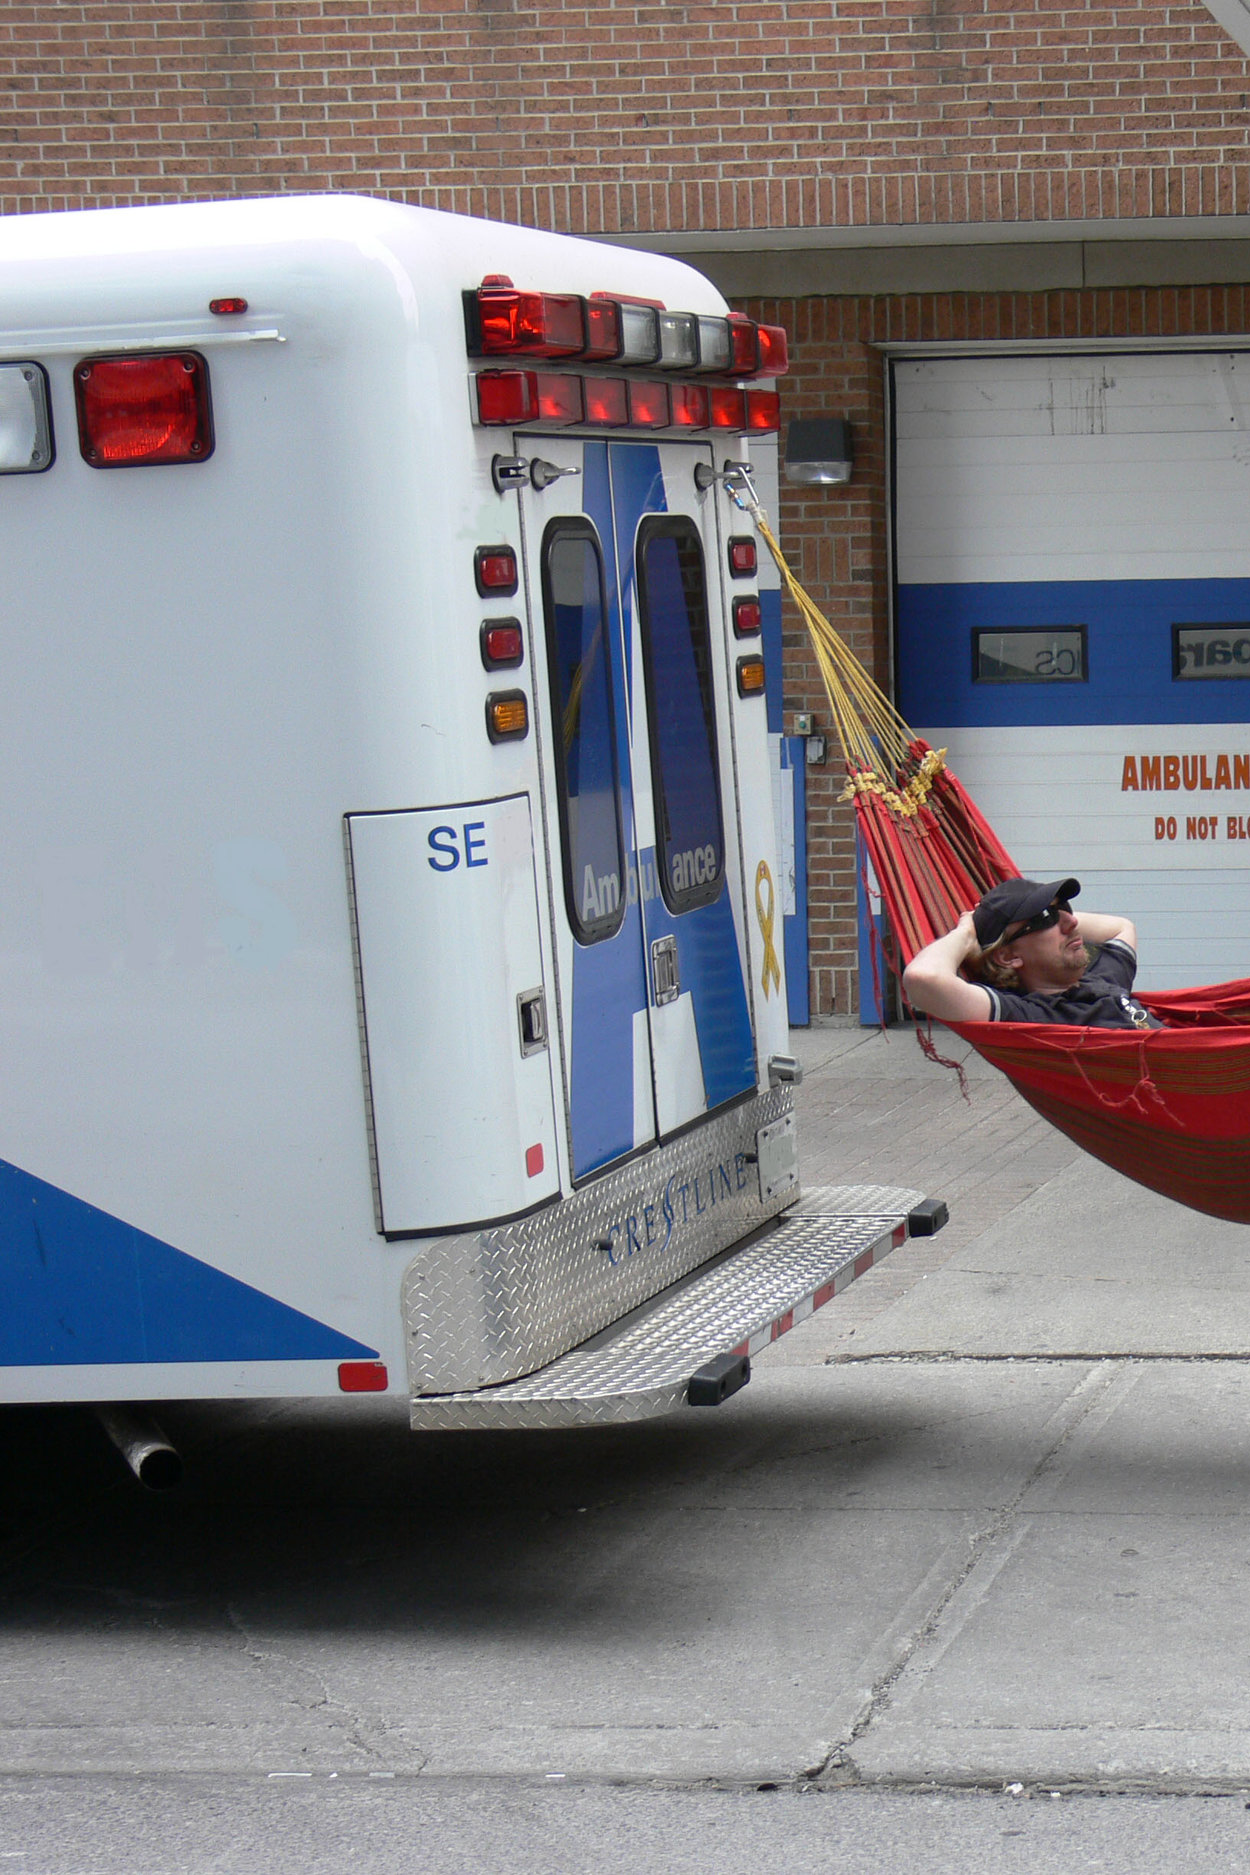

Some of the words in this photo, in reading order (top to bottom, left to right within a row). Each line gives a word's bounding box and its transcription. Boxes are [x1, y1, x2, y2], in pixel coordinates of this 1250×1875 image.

[427, 821, 488, 872] SE
[1155, 816, 1177, 840] DO
[1186, 816, 1218, 840] NOT
[607, 1152, 747, 1266] CRESTLINE
